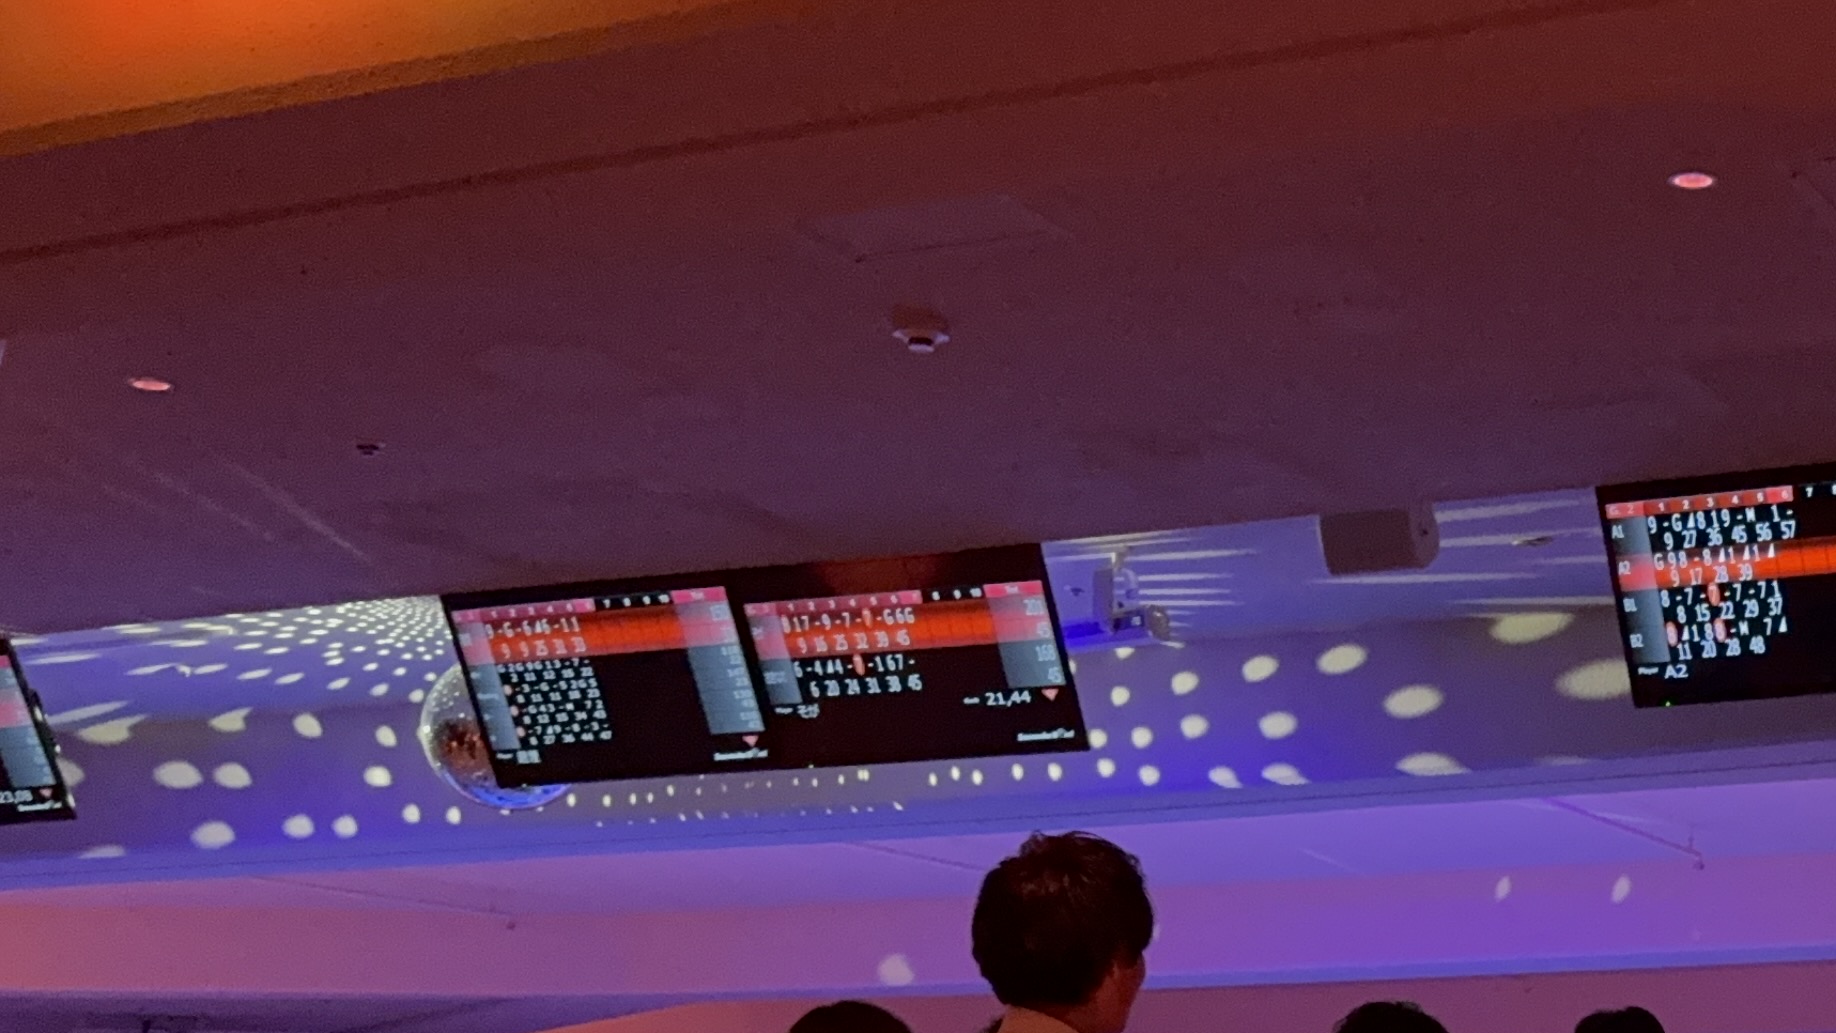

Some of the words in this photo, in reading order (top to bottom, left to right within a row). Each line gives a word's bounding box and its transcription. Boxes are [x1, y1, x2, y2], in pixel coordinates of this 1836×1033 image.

[1664, 532, 1674, 550] 9
[1682, 530, 1697, 549] 27
[1706, 528, 1723, 546] 36
[1731, 525, 1748, 544] 45
[1756, 522, 1772, 541] 56
[1781, 520, 1796, 539] 57
[1670, 570, 1680, 587] 9
[1690, 568, 1702, 585] 17
[1713, 565, 1728, 583] 28
[1738, 563, 1752, 581] 39
[1676, 605, 1686, 623] 8
[1695, 604, 1710, 622] 15
[1720, 601, 1736, 619] 22
[1743, 600, 1759, 618] 29
[1768, 598, 1782, 616] 37
[1677, 642, 1692, 660] 11
[1725, 638, 1741, 656] 28
[1750, 636, 1766, 654] 48
[1665, 664, 1688, 678] A2
[985, 690, 1031, 707] 21,44
